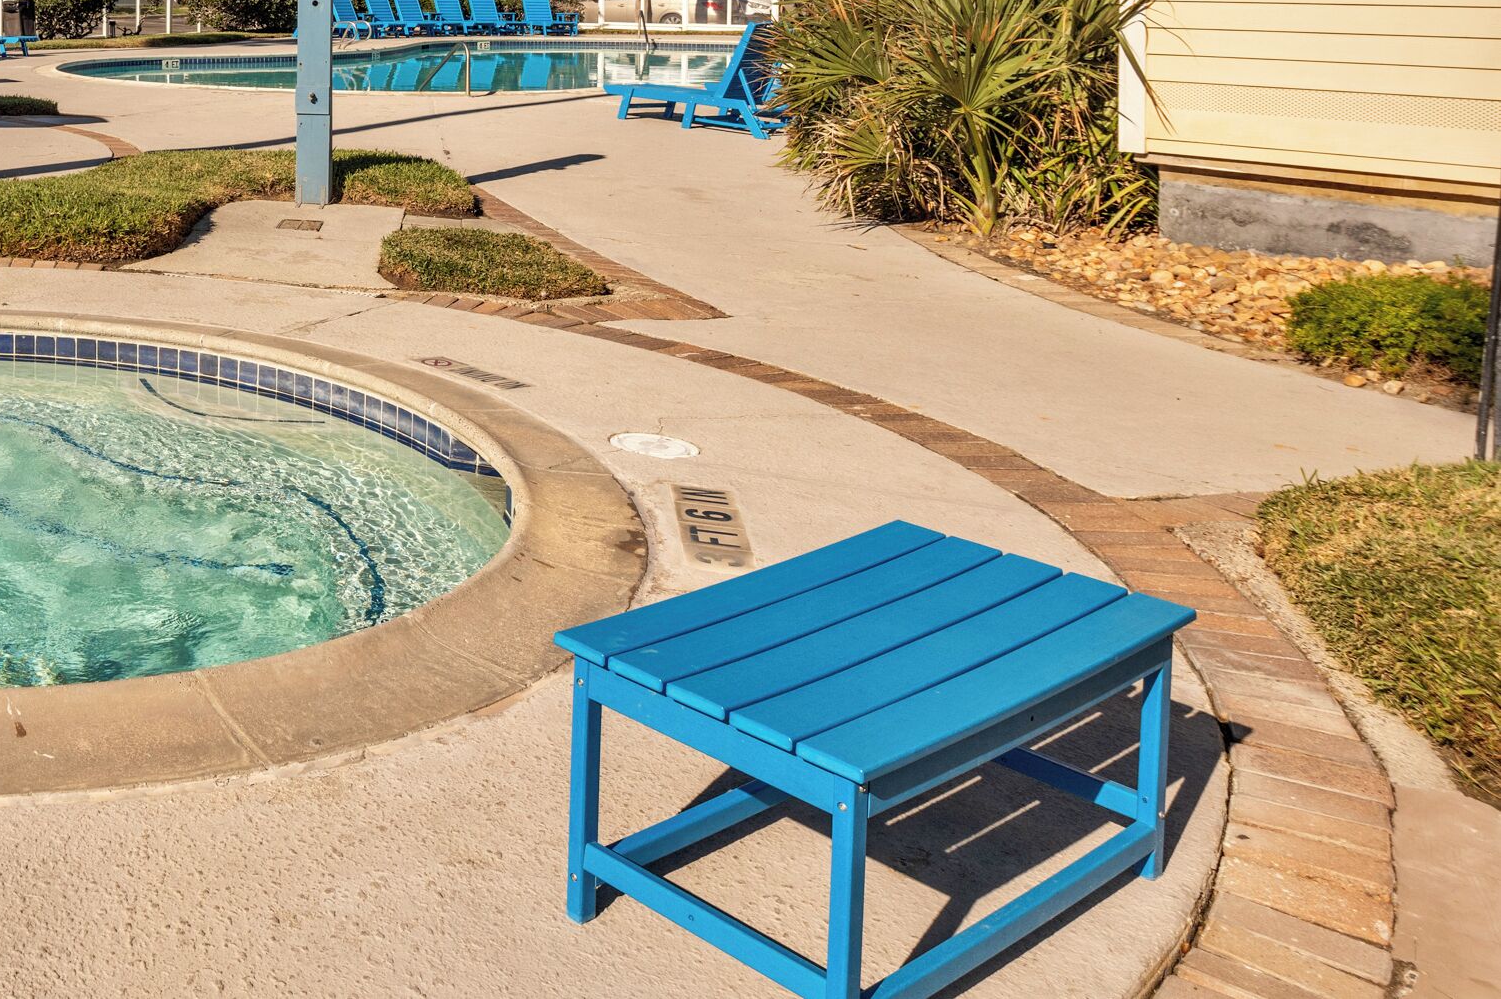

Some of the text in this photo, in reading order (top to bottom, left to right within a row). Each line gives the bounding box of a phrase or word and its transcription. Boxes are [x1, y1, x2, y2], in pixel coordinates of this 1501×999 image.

[679, 486, 730, 506] IN
[684, 508, 733, 522] 6
[689, 526, 742, 549] FT
